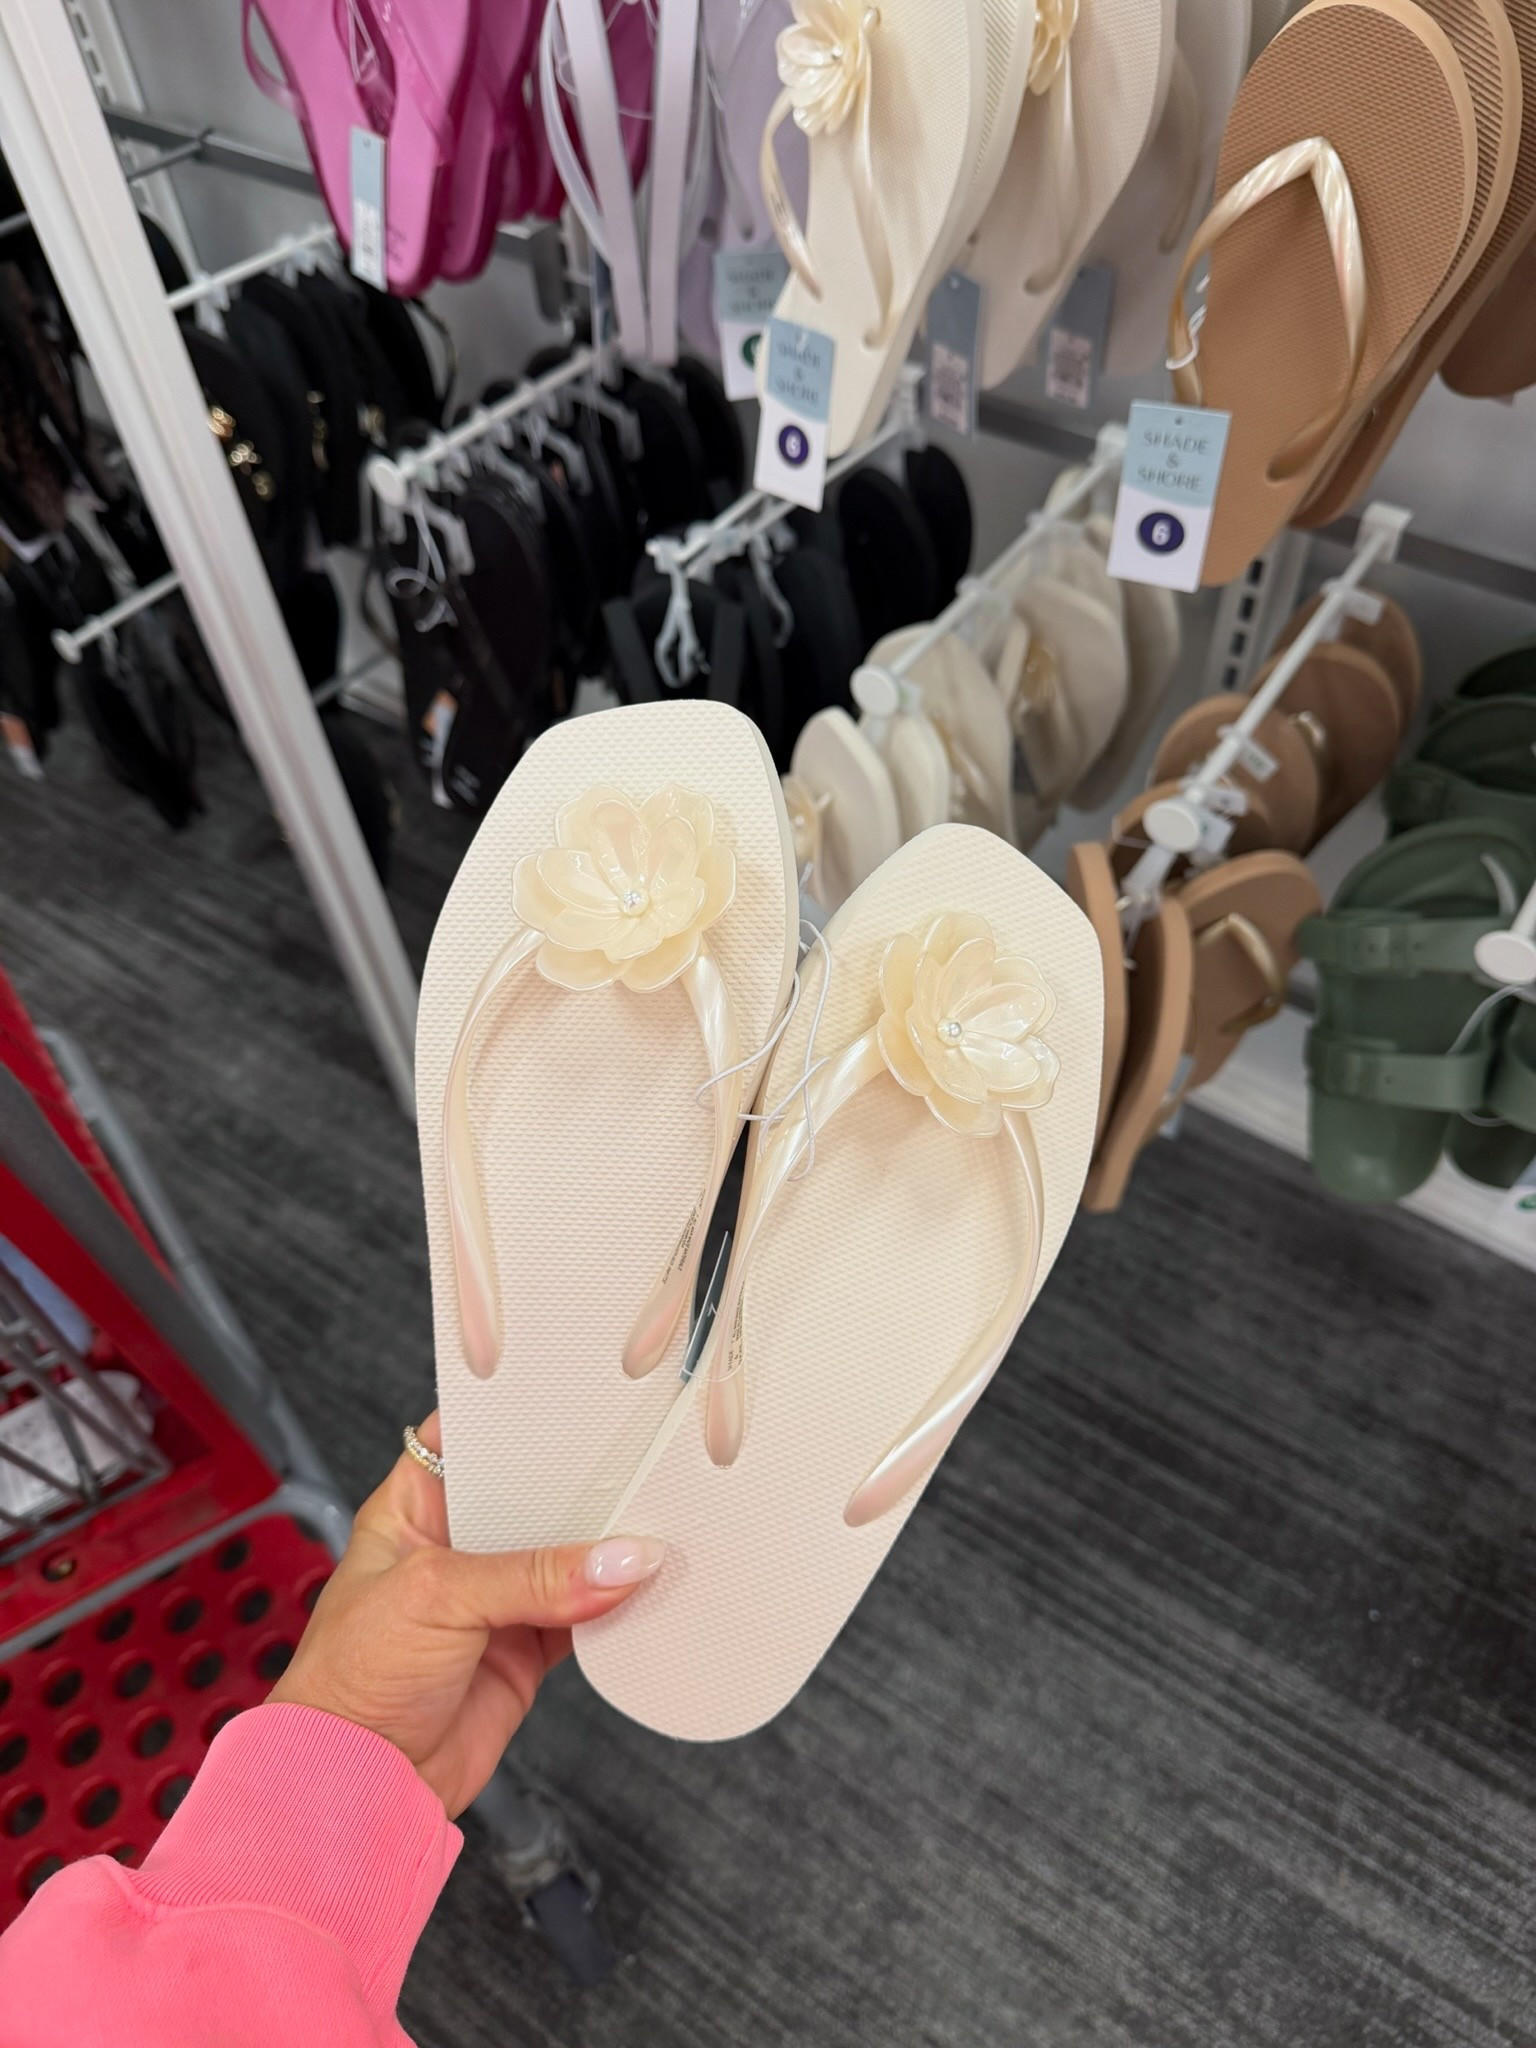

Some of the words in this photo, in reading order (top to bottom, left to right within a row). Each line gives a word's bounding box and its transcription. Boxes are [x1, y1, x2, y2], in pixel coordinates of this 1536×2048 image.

[1143, 430, 1209, 456] SHADE
[1165, 452, 1180, 469] &
[1138, 465, 1202, 492] SHORE
[1152, 519, 1171, 546] 6
